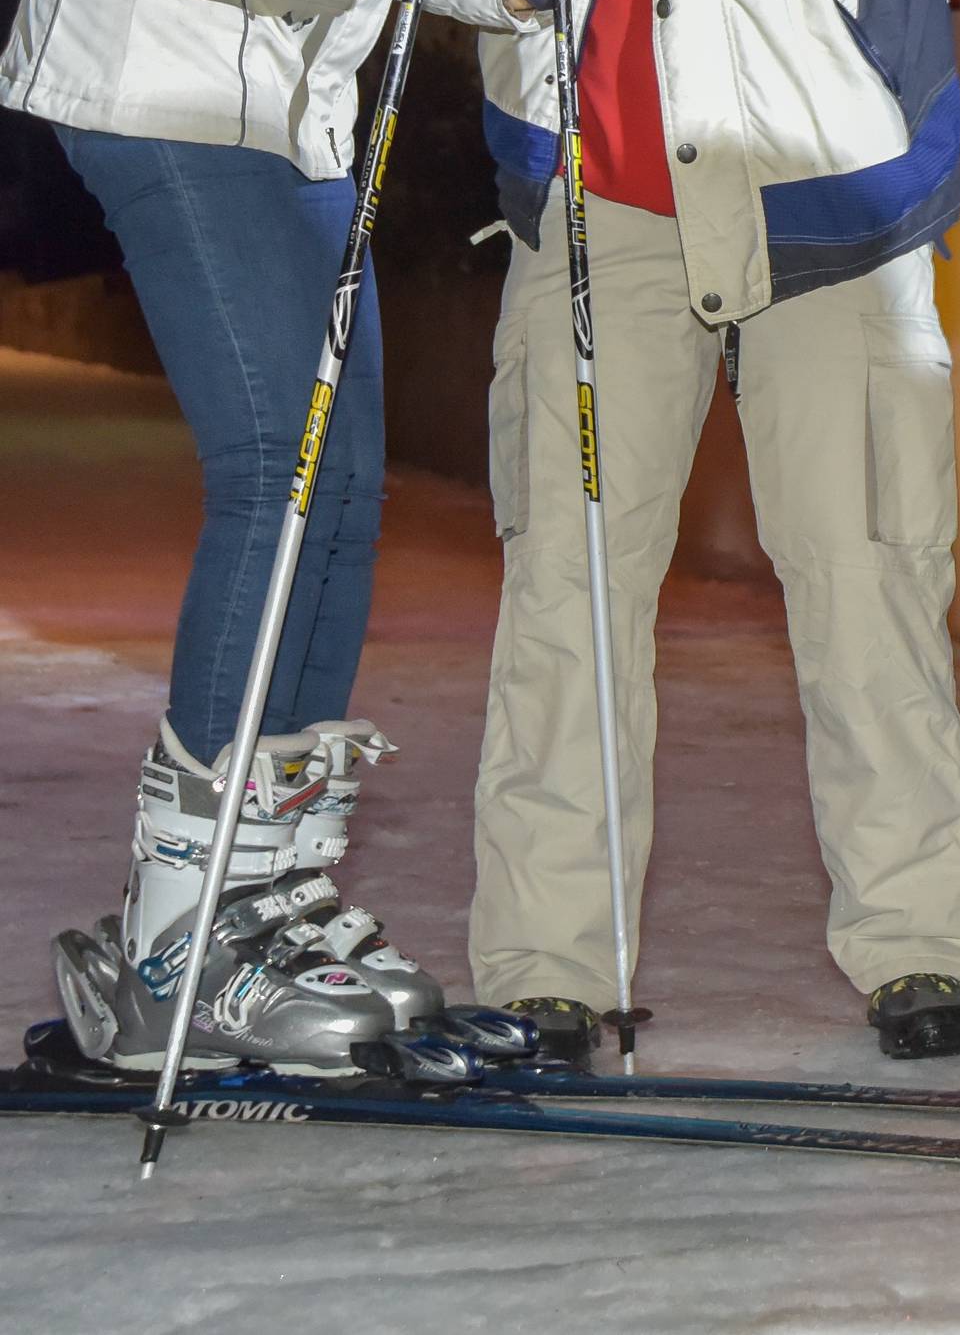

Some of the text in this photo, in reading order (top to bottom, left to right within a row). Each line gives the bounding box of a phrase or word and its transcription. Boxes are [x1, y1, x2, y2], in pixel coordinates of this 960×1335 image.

[289, 379, 333, 516] SCOTT
[577, 382, 600, 502] SCOTT
[172, 1099, 310, 1122] ATOMIC
